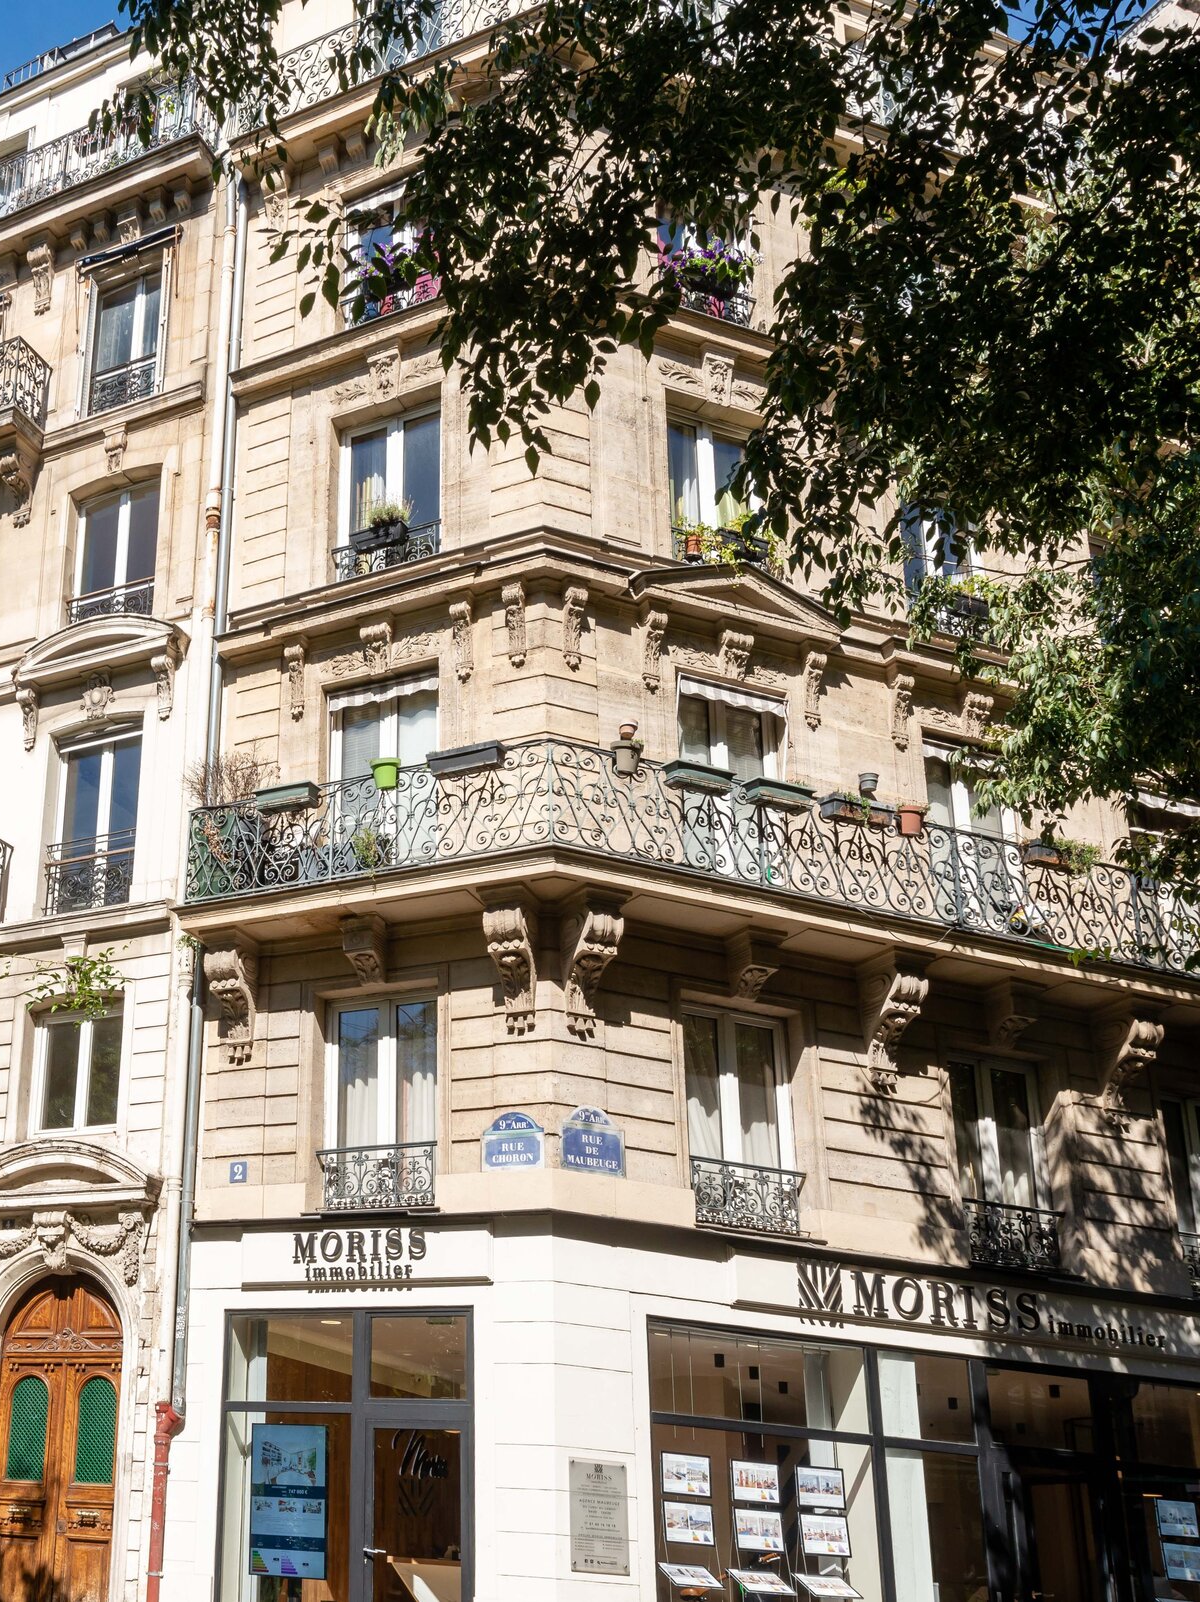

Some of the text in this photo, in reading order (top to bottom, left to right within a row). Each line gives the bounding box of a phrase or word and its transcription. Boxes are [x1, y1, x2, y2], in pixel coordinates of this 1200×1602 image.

[501, 1142, 524, 1152] RUE
[582, 1134, 603, 1145] RUE
[492, 1153, 534, 1163] CHORON
[585, 1147, 599, 1155] DE
[567, 1155, 618, 1170] MAUBEUGE
[233, 1164, 243, 1180] 2
[292, 1228, 427, 1264] MORISS
[304, 1261, 413, 1281] immobilier
[850, 1270, 1166, 1349] MORISS immobilier
